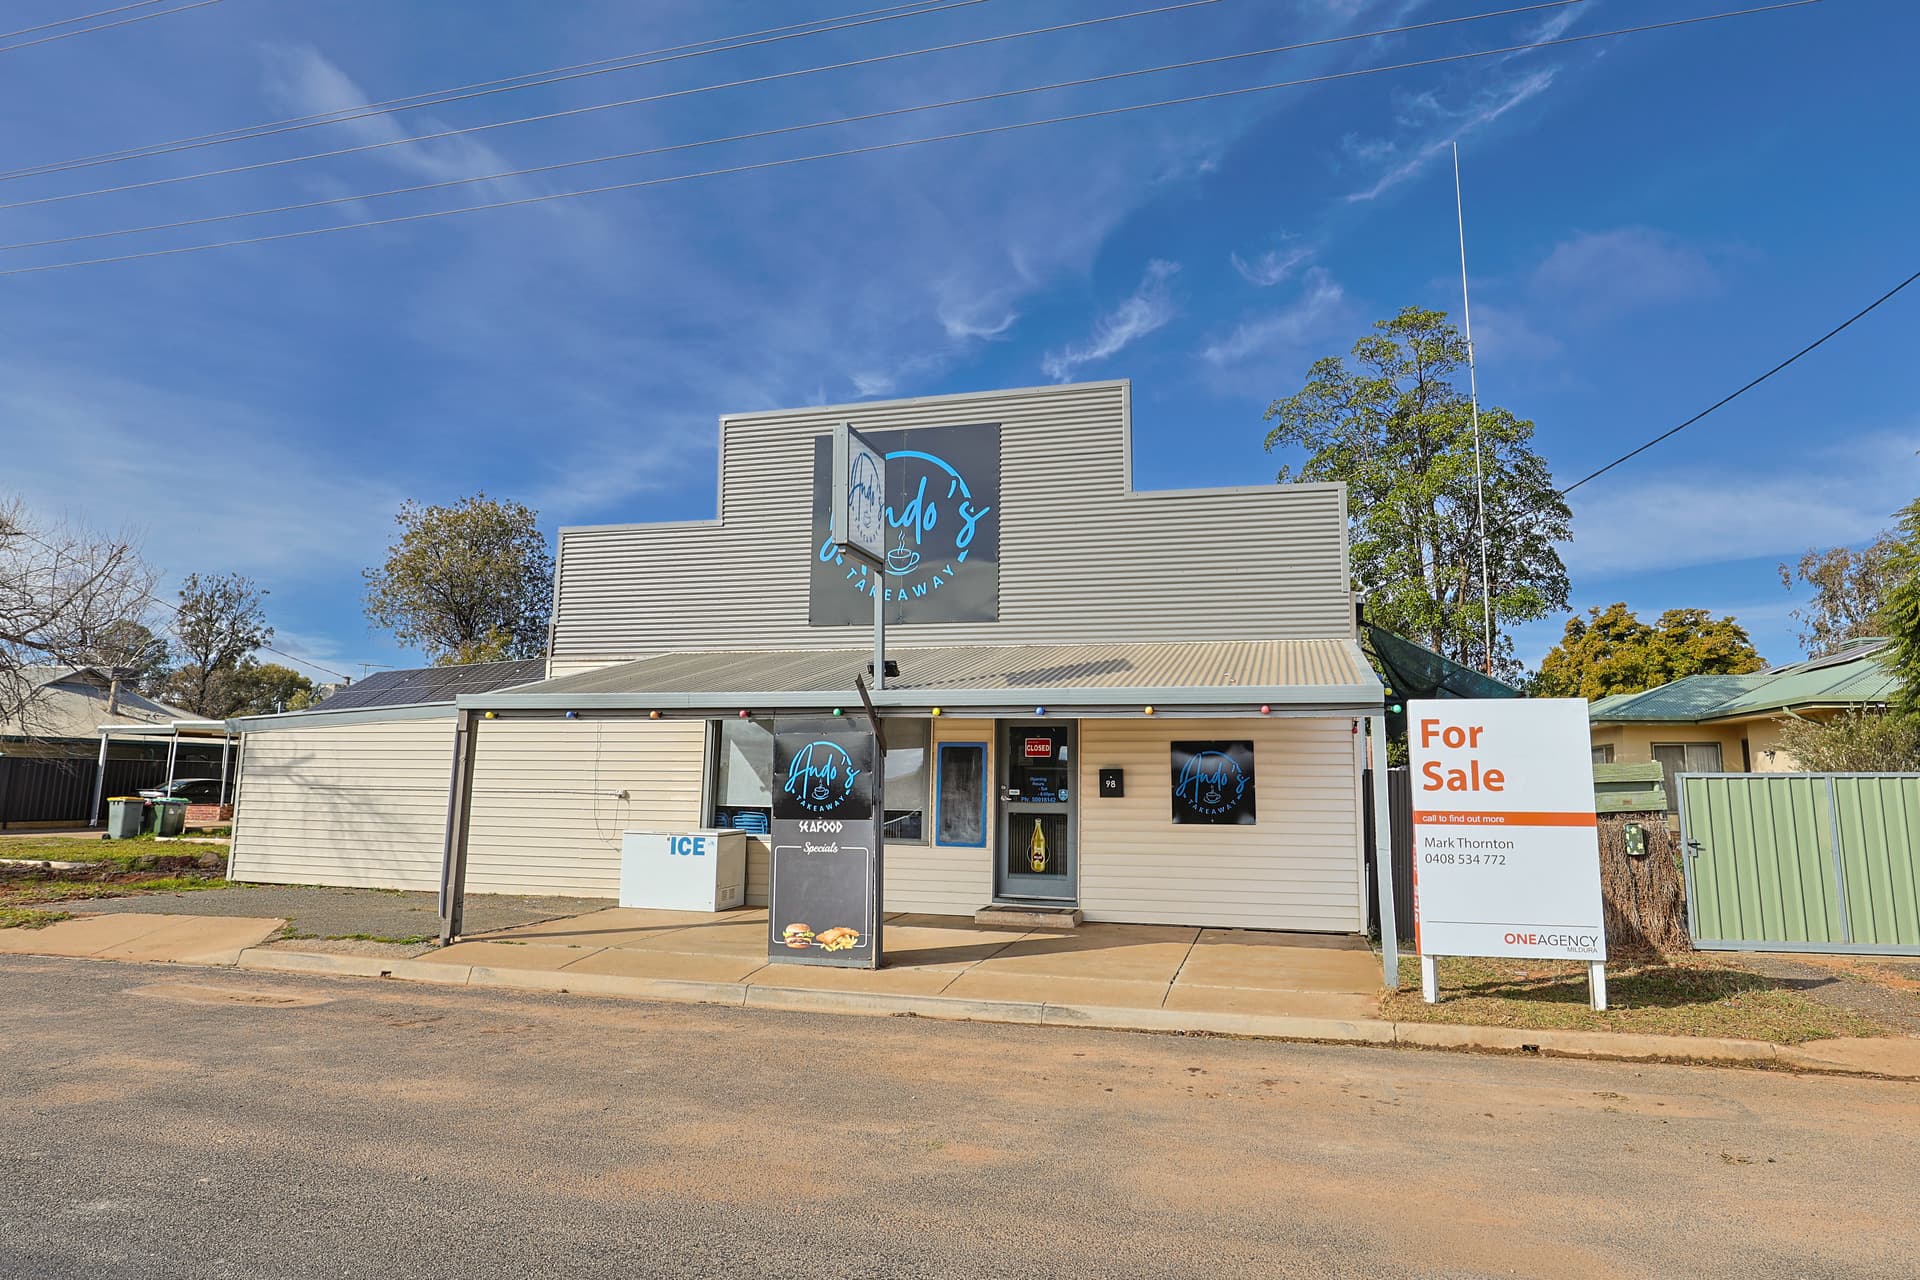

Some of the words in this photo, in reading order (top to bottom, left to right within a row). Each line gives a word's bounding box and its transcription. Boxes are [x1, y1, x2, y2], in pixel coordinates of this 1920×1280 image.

[1421, 719, 1483, 748] For
[784, 743, 861, 799] Ando's
[1175, 753, 1251, 803] Ando's
[1422, 760, 1505, 791] Sale
[1105, 780, 1117, 788] 98
[796, 795, 845, 812] TAKEAWAY
[799, 821, 843, 833] SEAFOOD
[670, 836, 706, 856] ICE
[803, 841, 839, 855] Specials
[1424, 837, 1455, 848] Mark
[1456, 837, 1514, 849] Thornton
[1424, 853, 1455, 864] 0408
[1458, 854, 1480, 865] 534
[1483, 854, 1506, 866] 772
